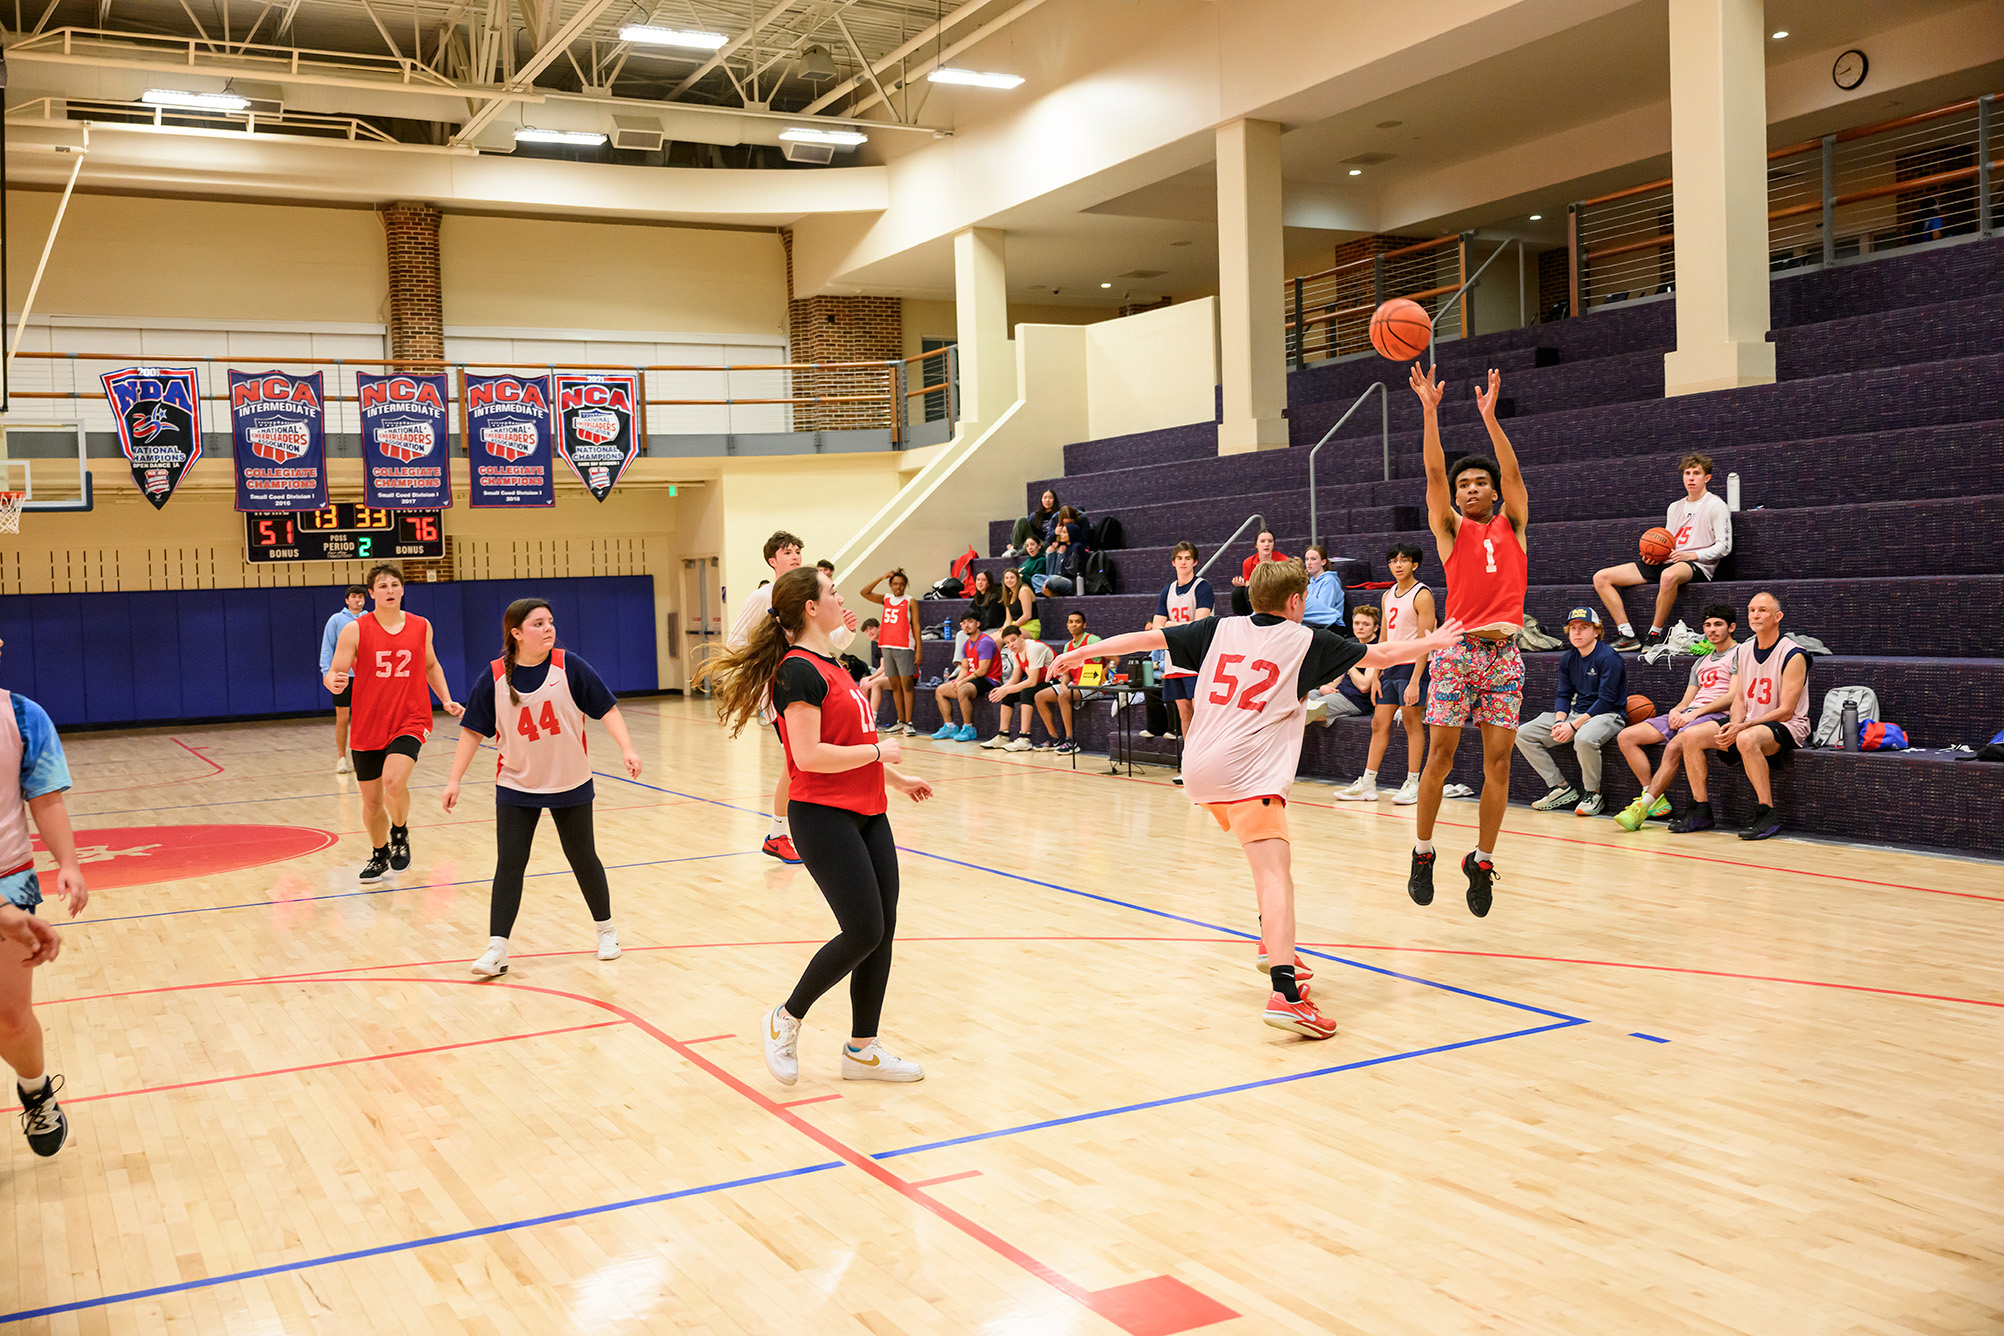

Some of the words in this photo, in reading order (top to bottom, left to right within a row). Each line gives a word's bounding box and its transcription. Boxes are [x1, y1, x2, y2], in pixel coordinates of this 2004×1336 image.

[111, 379, 193, 418] NDA
[232, 376, 321, 411] NCA
[361, 377, 445, 412] NCA
[468, 379, 549, 413] NCA
[560, 385, 634, 416] NCA
[239, 403, 316, 418] INTERMEDIATE
[367, 403, 441, 418] INTERMEDIATE
[474, 403, 544, 419] INTERMEDIATE
[261, 426, 299, 434] NATIONAL
[387, 425, 424, 434] NATIONAL
[493, 425, 528, 434] NATIONAL
[132, 454, 186, 462] HAMPIONS
[244, 467, 318, 478] COLLEGIATE
[373, 466, 442, 477] COLLEGIATE
[478, 465, 545, 476] COLLEGIATE
[246, 479, 317, 489] CHAMPIONS
[374, 478, 442, 488] CHAMPIONS
[480, 476, 544, 487] CHAMPIONS
[258, 520, 293, 545] 51
[405, 517, 437, 541] 76
[269, 549, 300, 558] BONUS
[323, 542, 355, 551] PERIOD
[358, 537, 372, 557] 2
[395, 545, 424, 555] BONUS
[1483, 539, 1497, 573] 1
[884, 608, 900, 624] 55
[1171, 606, 1190, 623] 35
[1388, 607, 1399, 629] 2
[375, 649, 412, 678] 52
[1208, 653, 1280, 714] 52
[517, 699, 561, 743] 44
